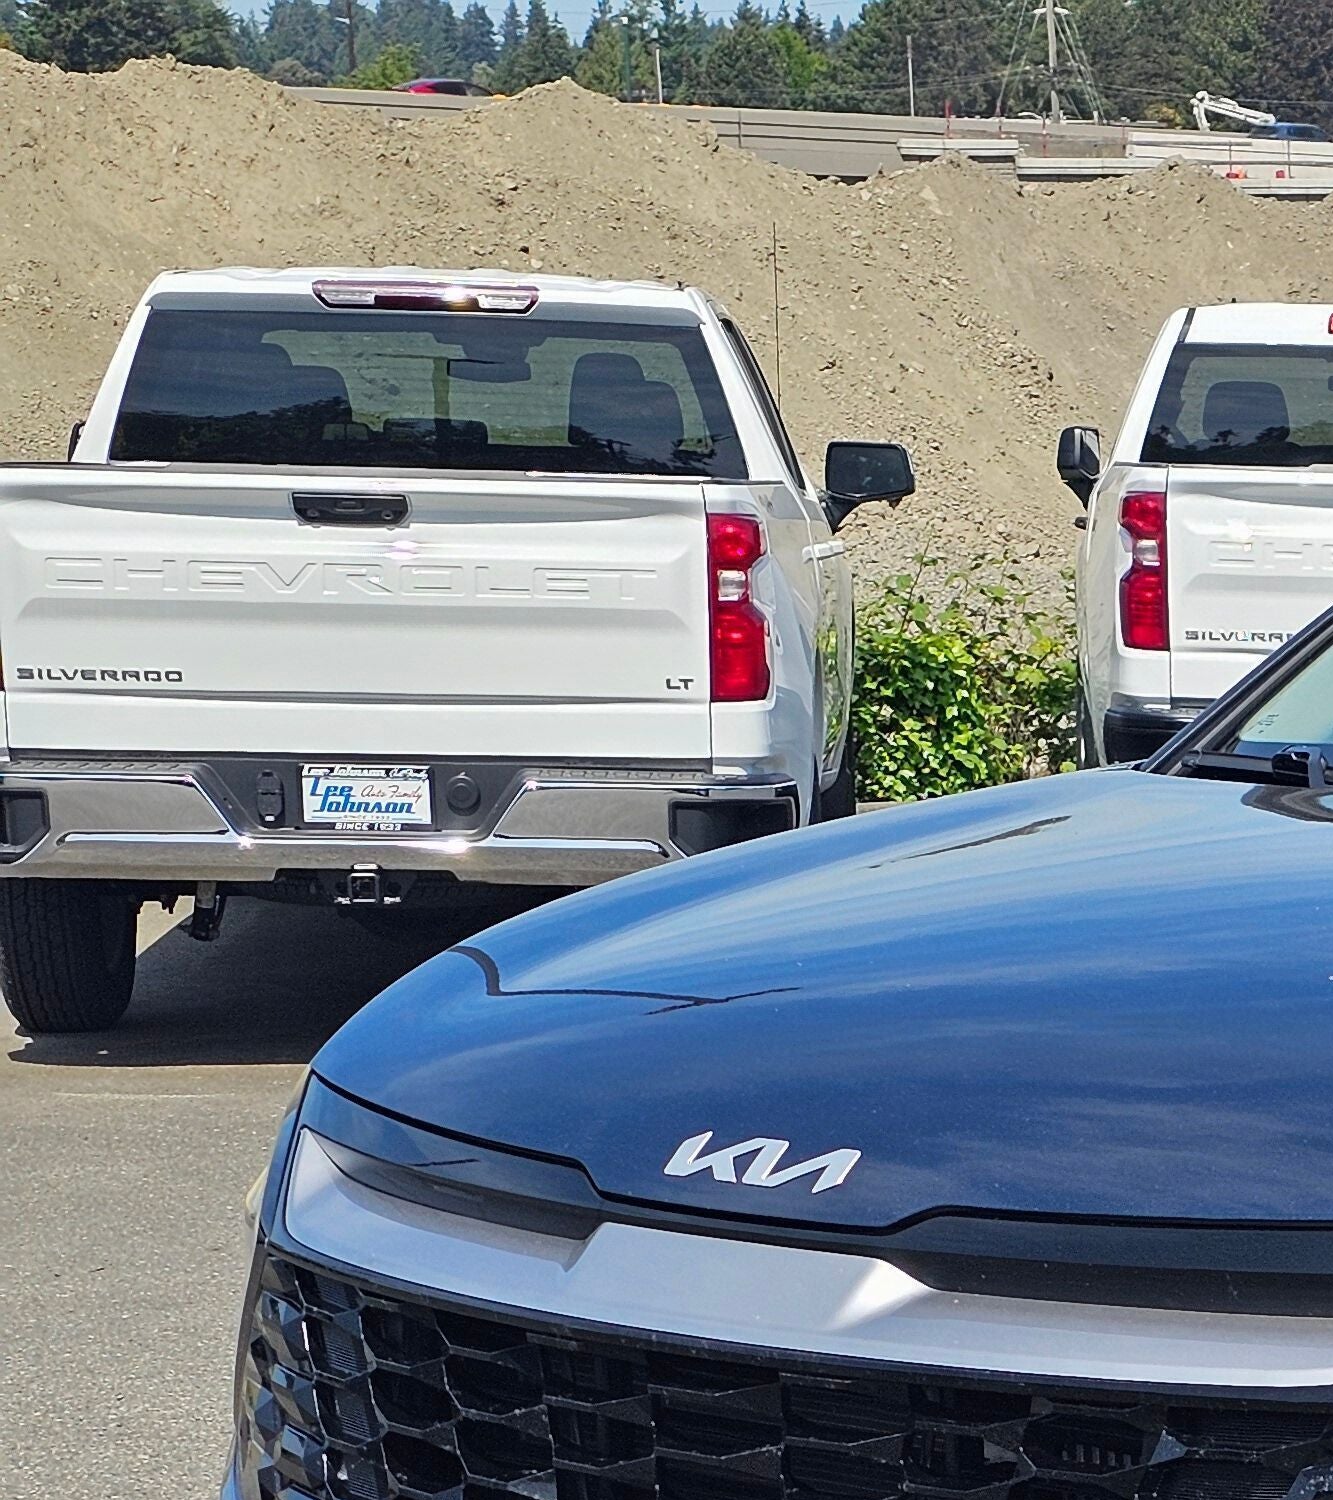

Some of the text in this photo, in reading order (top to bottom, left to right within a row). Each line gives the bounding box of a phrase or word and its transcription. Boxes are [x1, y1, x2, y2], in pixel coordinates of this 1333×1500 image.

[44, 556, 657, 601] CHEVROLET
[16, 667, 184, 684] SILVERADO
[665, 677, 695, 692] LT
[310, 776, 357, 798] Lee
[312, 795, 416, 814] Johnson
